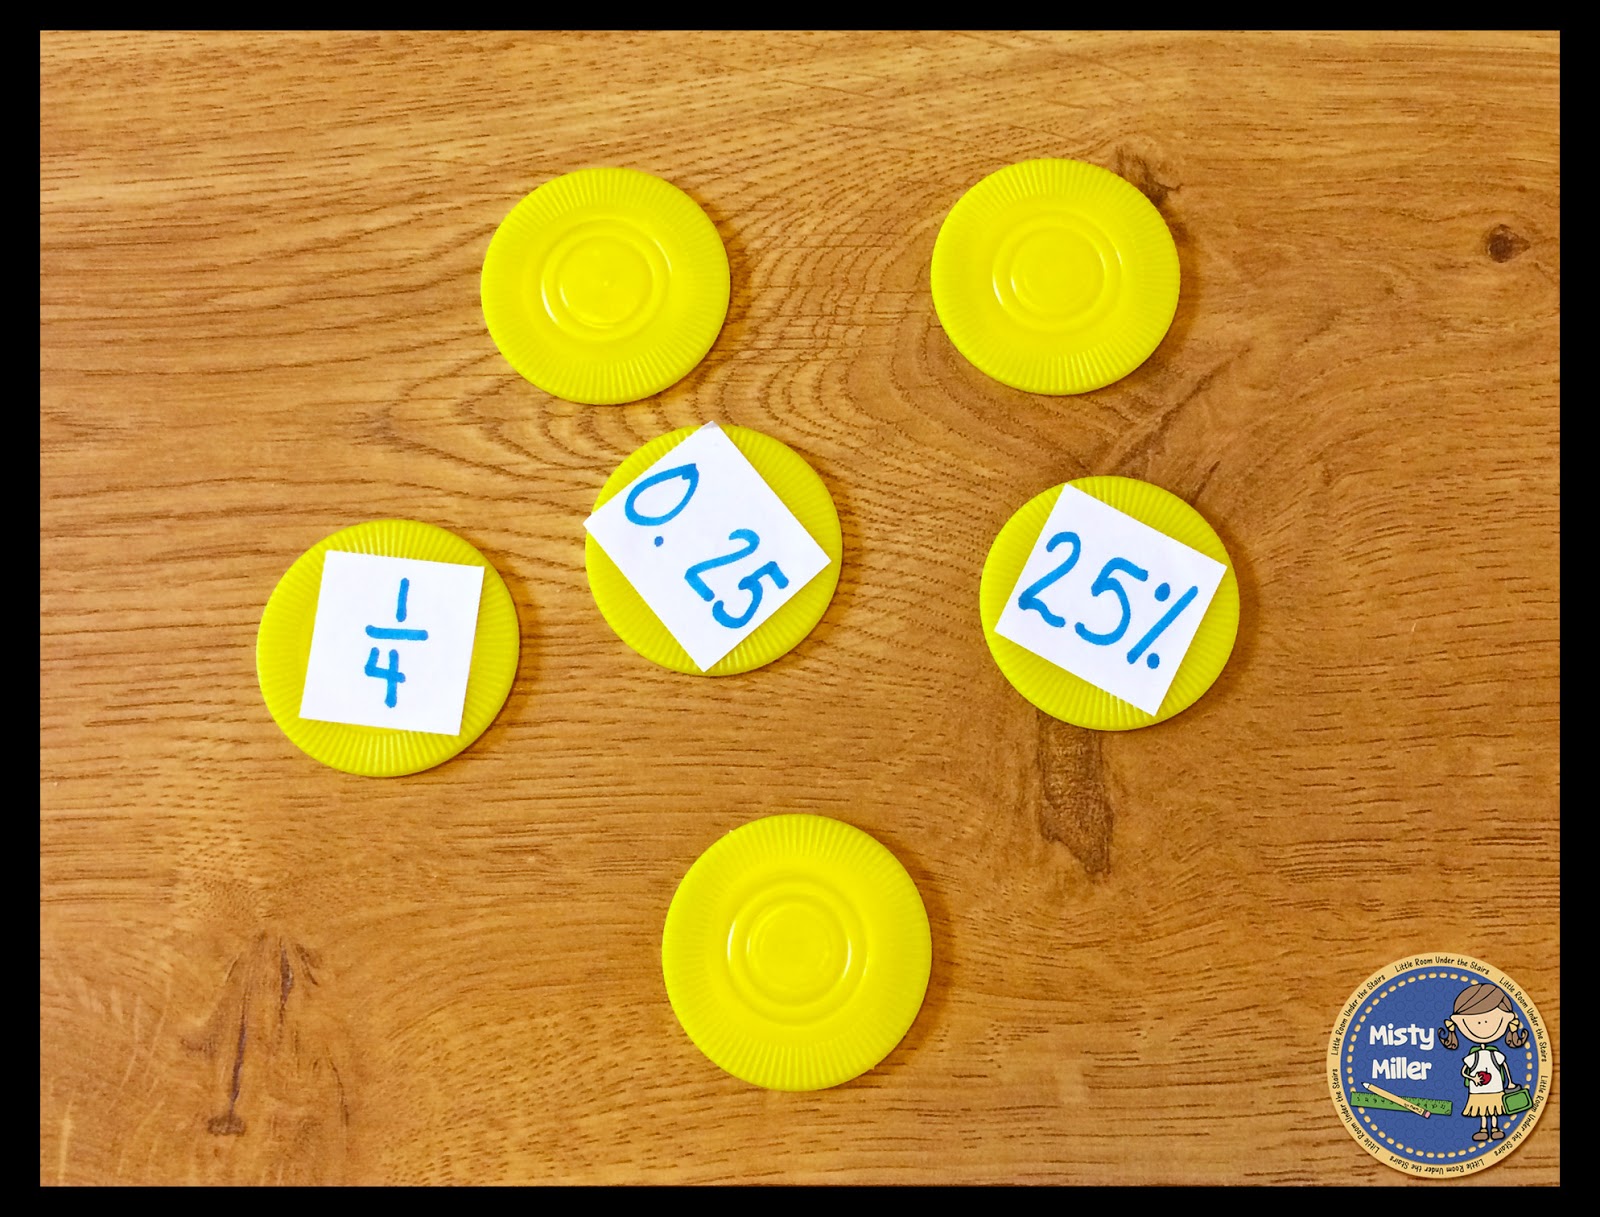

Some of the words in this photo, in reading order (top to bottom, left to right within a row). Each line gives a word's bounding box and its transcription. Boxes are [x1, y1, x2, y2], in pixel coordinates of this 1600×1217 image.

[624, 463, 789, 629] 0.25
[1018, 531, 1198, 669] 25%
[364, 647, 406, 708] 4
